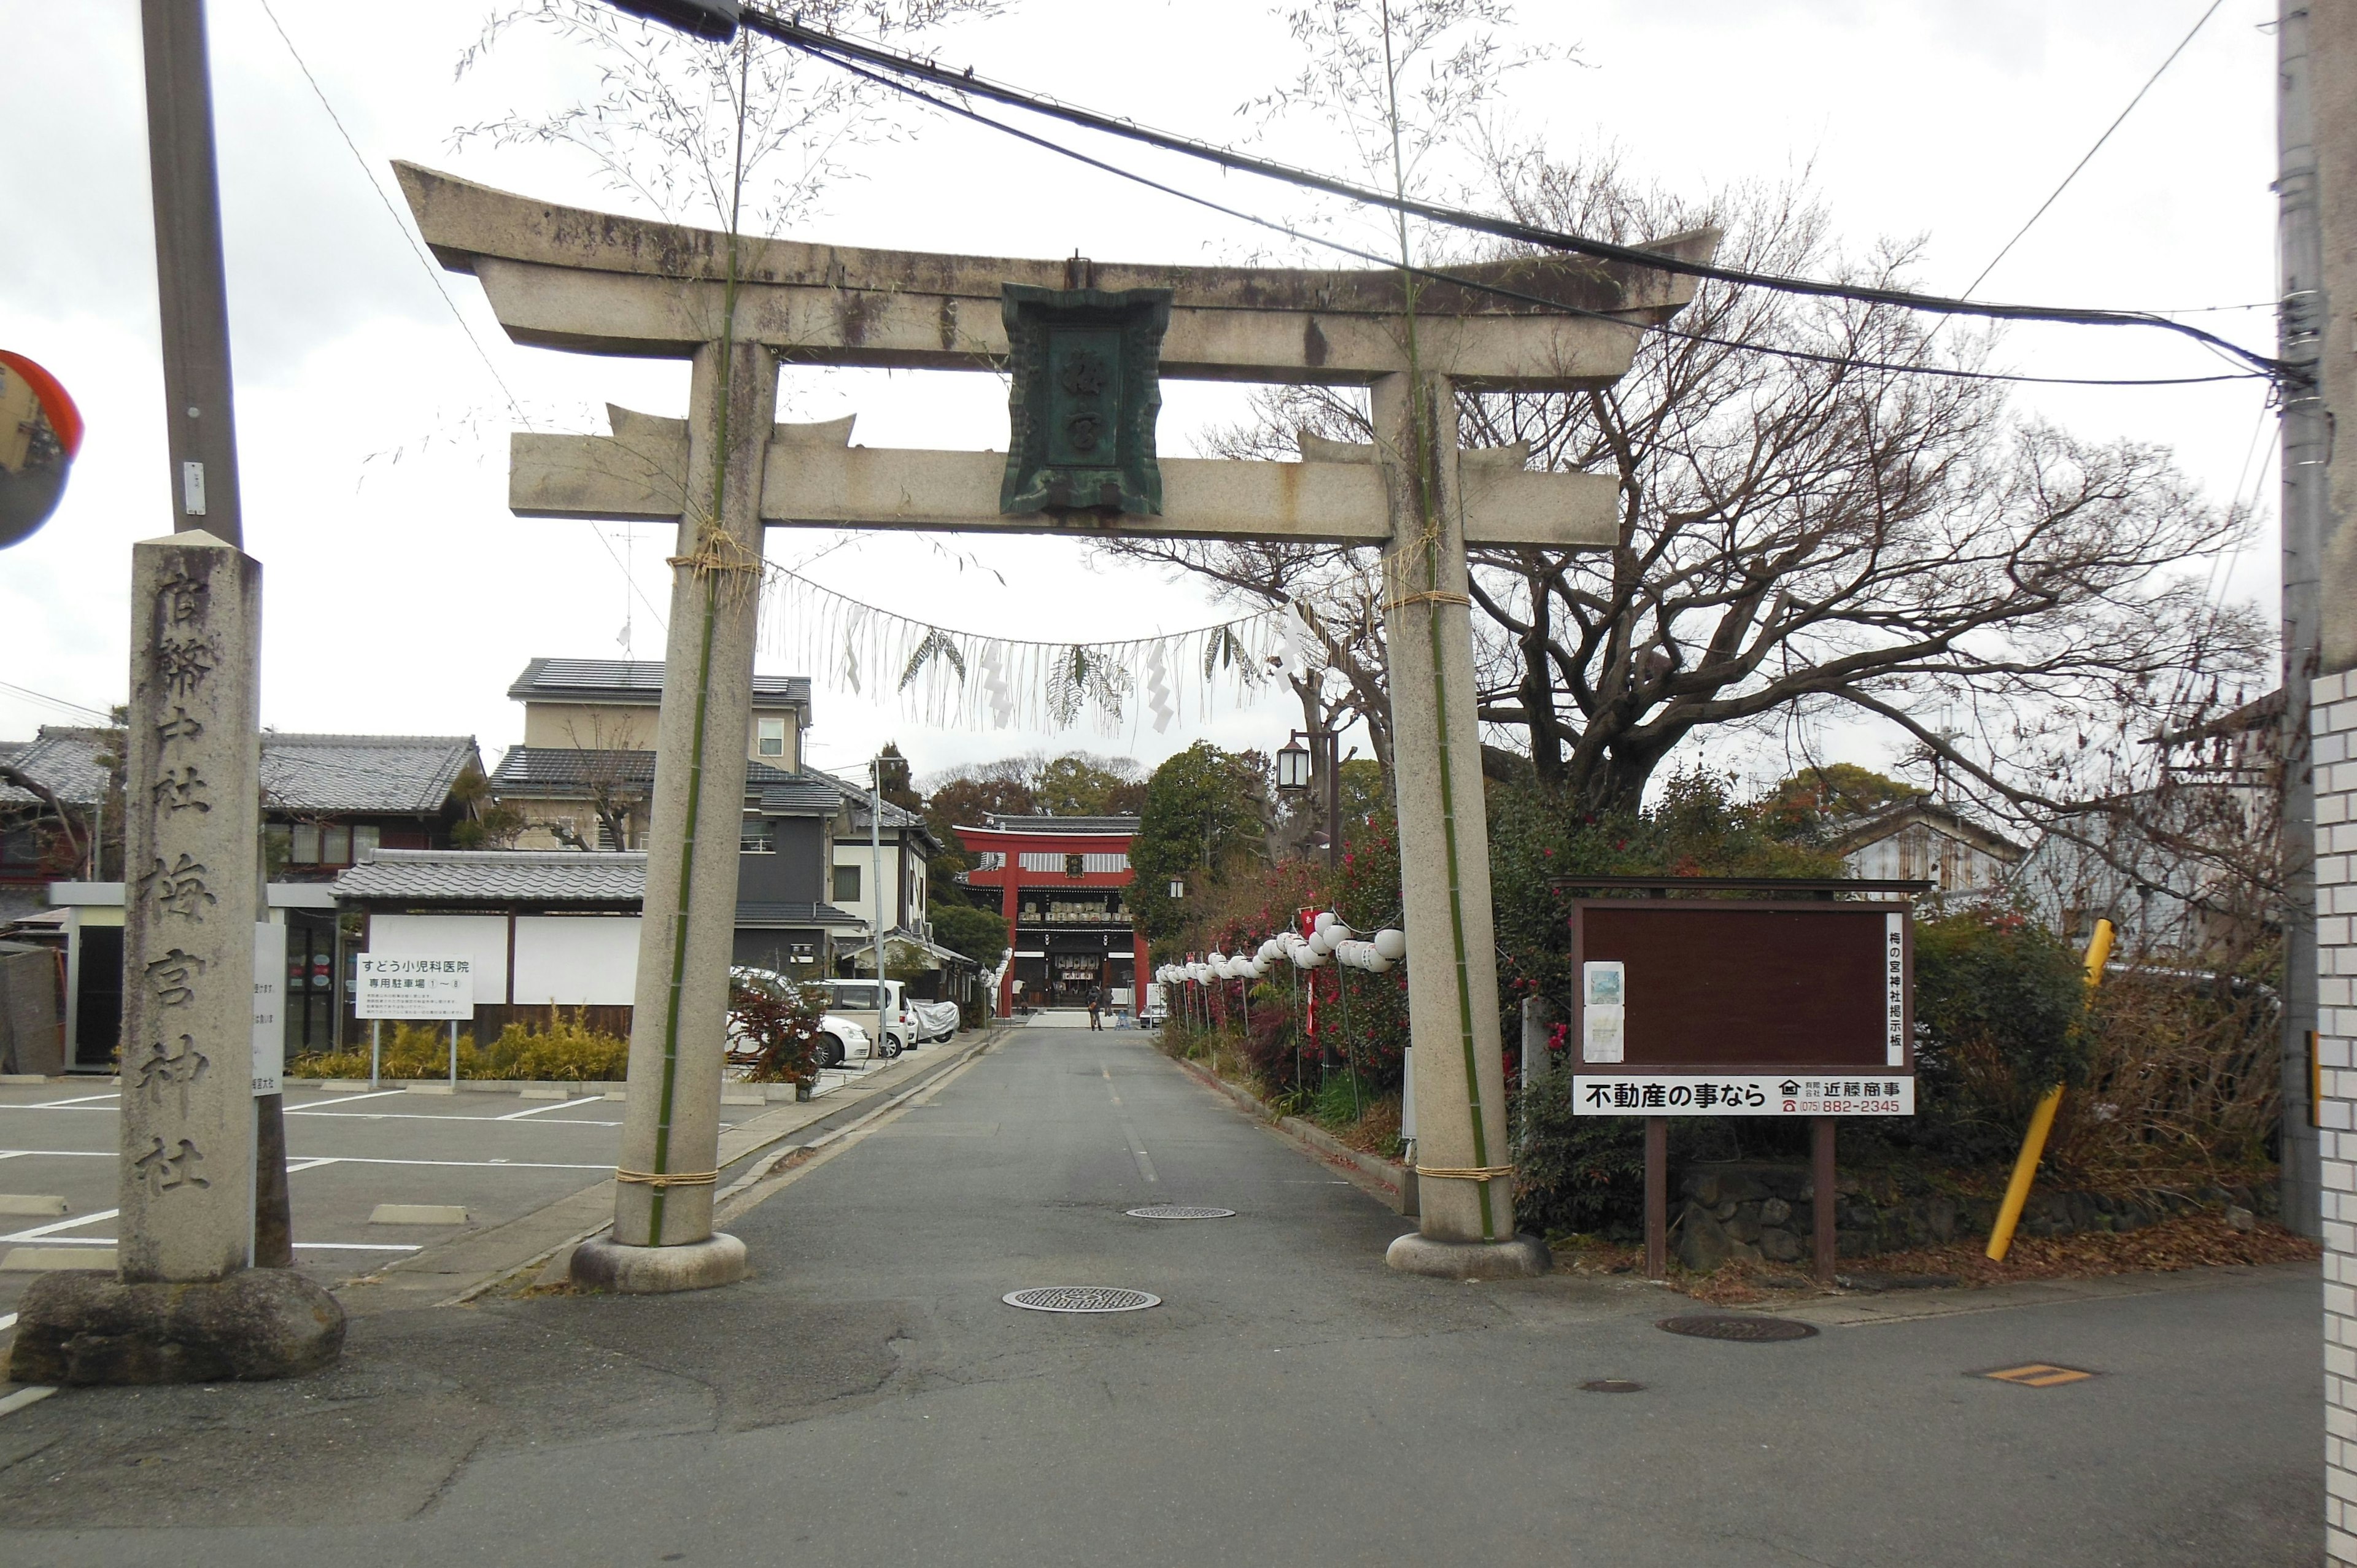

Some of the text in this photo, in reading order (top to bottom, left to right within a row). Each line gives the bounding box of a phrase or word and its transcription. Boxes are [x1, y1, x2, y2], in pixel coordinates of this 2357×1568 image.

[362, 960, 470, 973] すどう小児科医院
[1889, 932, 1902, 1046] 梅の宮神社掲示板
[1585, 1083, 1766, 1108] 不動産の事なら
[1824, 1081, 1900, 1097] 近藤商事
[1800, 1100, 1900, 1112] (075) 882-2345
